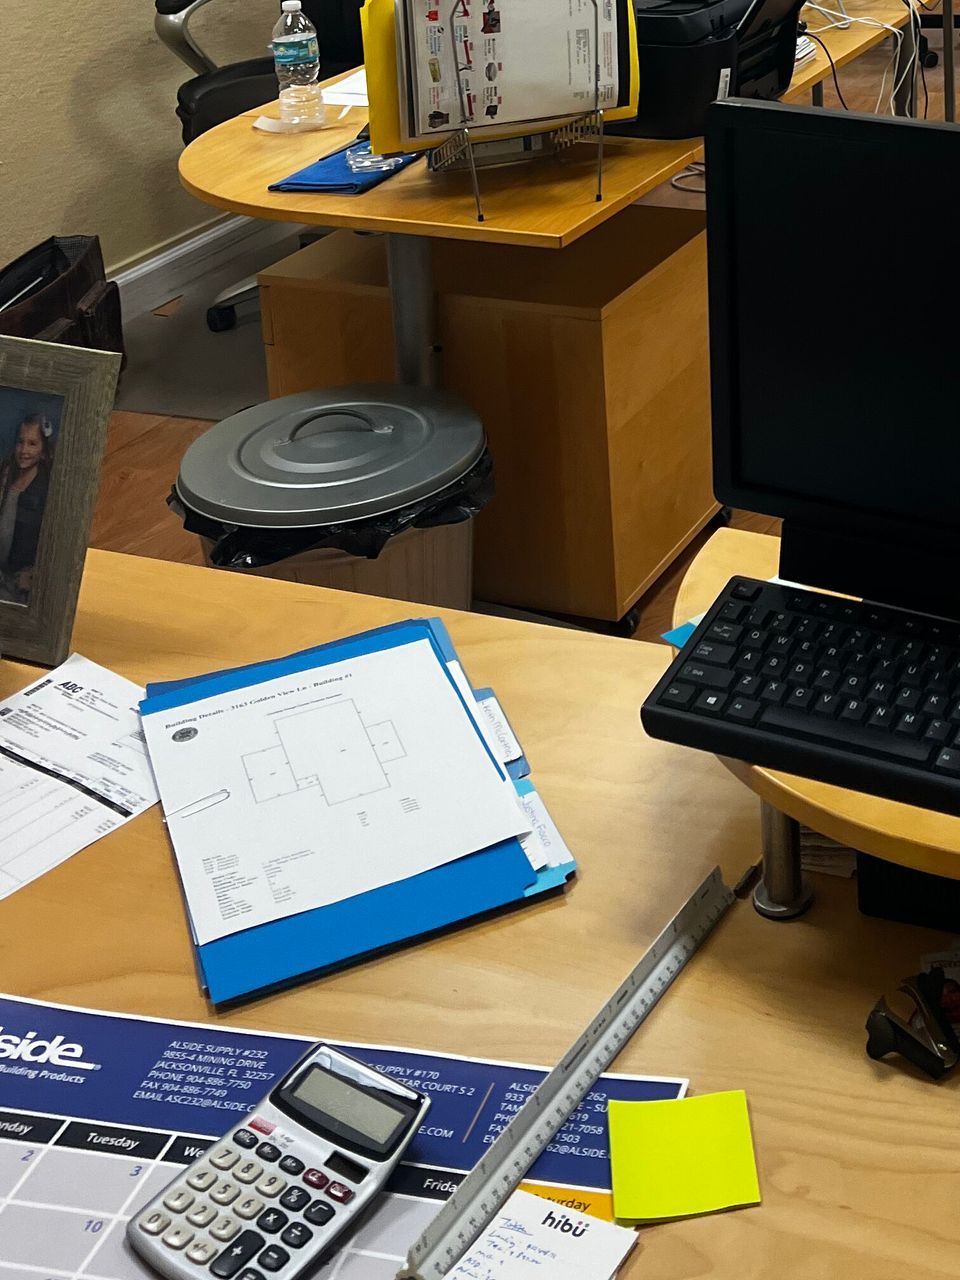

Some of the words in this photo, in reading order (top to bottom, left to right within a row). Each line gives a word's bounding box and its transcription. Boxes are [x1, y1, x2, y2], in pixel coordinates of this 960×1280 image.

[777, 635, 788, 645] W
[801, 641, 811, 651] E
[855, 653, 864, 662] T
[881, 659, 891, 668] Y
[908, 666, 917, 674] U
[58, 680, 84, 694] ABC
[743, 652, 752, 661] A
[769, 658, 779, 667] S
[795, 664, 805, 673] D
[821, 669, 831, 678] F
[848, 677, 858, 686] G
[875, 682, 884, 692] H
[902, 689, 910, 697] J
[930, 695, 939, 704] K
[742, 676, 752, 685] Z
[769, 682, 778, 691] X
[795, 688, 805, 697] C
[823, 695, 832, 703] V
[849, 701, 858, 710] B
[875, 707, 886, 717] N
[904, 714, 915, 723] M
[0, 1026, 102, 1071] side
[168, 1040, 205, 1053] ALSIDE
[204, 1044, 242, 1058] SUPPLY
[242, 1049, 269, 1059] #232
[162, 1050, 195, 1061] 9855-4
[195, 1054, 236, 1067] MINING
[235, 1059, 267, 1070] DRIVE
[39, 1070, 87, 1084] Products
[147, 1070, 184, 1082] PHONE
[185, 1075, 252, 1090] 904-886-7750
[226, 1069, 238, 1078] FL
[242, 1071, 275, 1081] 32257
[413, 1069, 440, 1080] #170
[132, 1091, 164, 1102] EMAIL
[140, 1080, 160, 1090] FAX
[162, 1083, 228, 1098] 904-886-7749
[421, 1081, 459, 1093] COURT
[457, 1086, 466, 1095] S
[466, 1087, 476, 1096] 2
[504, 1092, 525, 1102] 933
[0, 1121, 33, 1135] nday
[86, 1132, 141, 1150] Tuesday
[21, 1149, 34, 1162] 2
[129, 1165, 143, 1177] 3
[218, 1149, 232, 1160] 7
[241, 1163, 254, 1174] 8
[265, 1176, 277, 1187] 9
[217, 1184, 231, 1194] 5
[241, 1198, 254, 1209] 6
[84, 1220, 103, 1233] 10
[147, 1213, 160, 1224] 0
[195, 1205, 207, 1216] 2
[218, 1219, 231, 1230] 3
[541, 1210, 590, 1238] hibü
